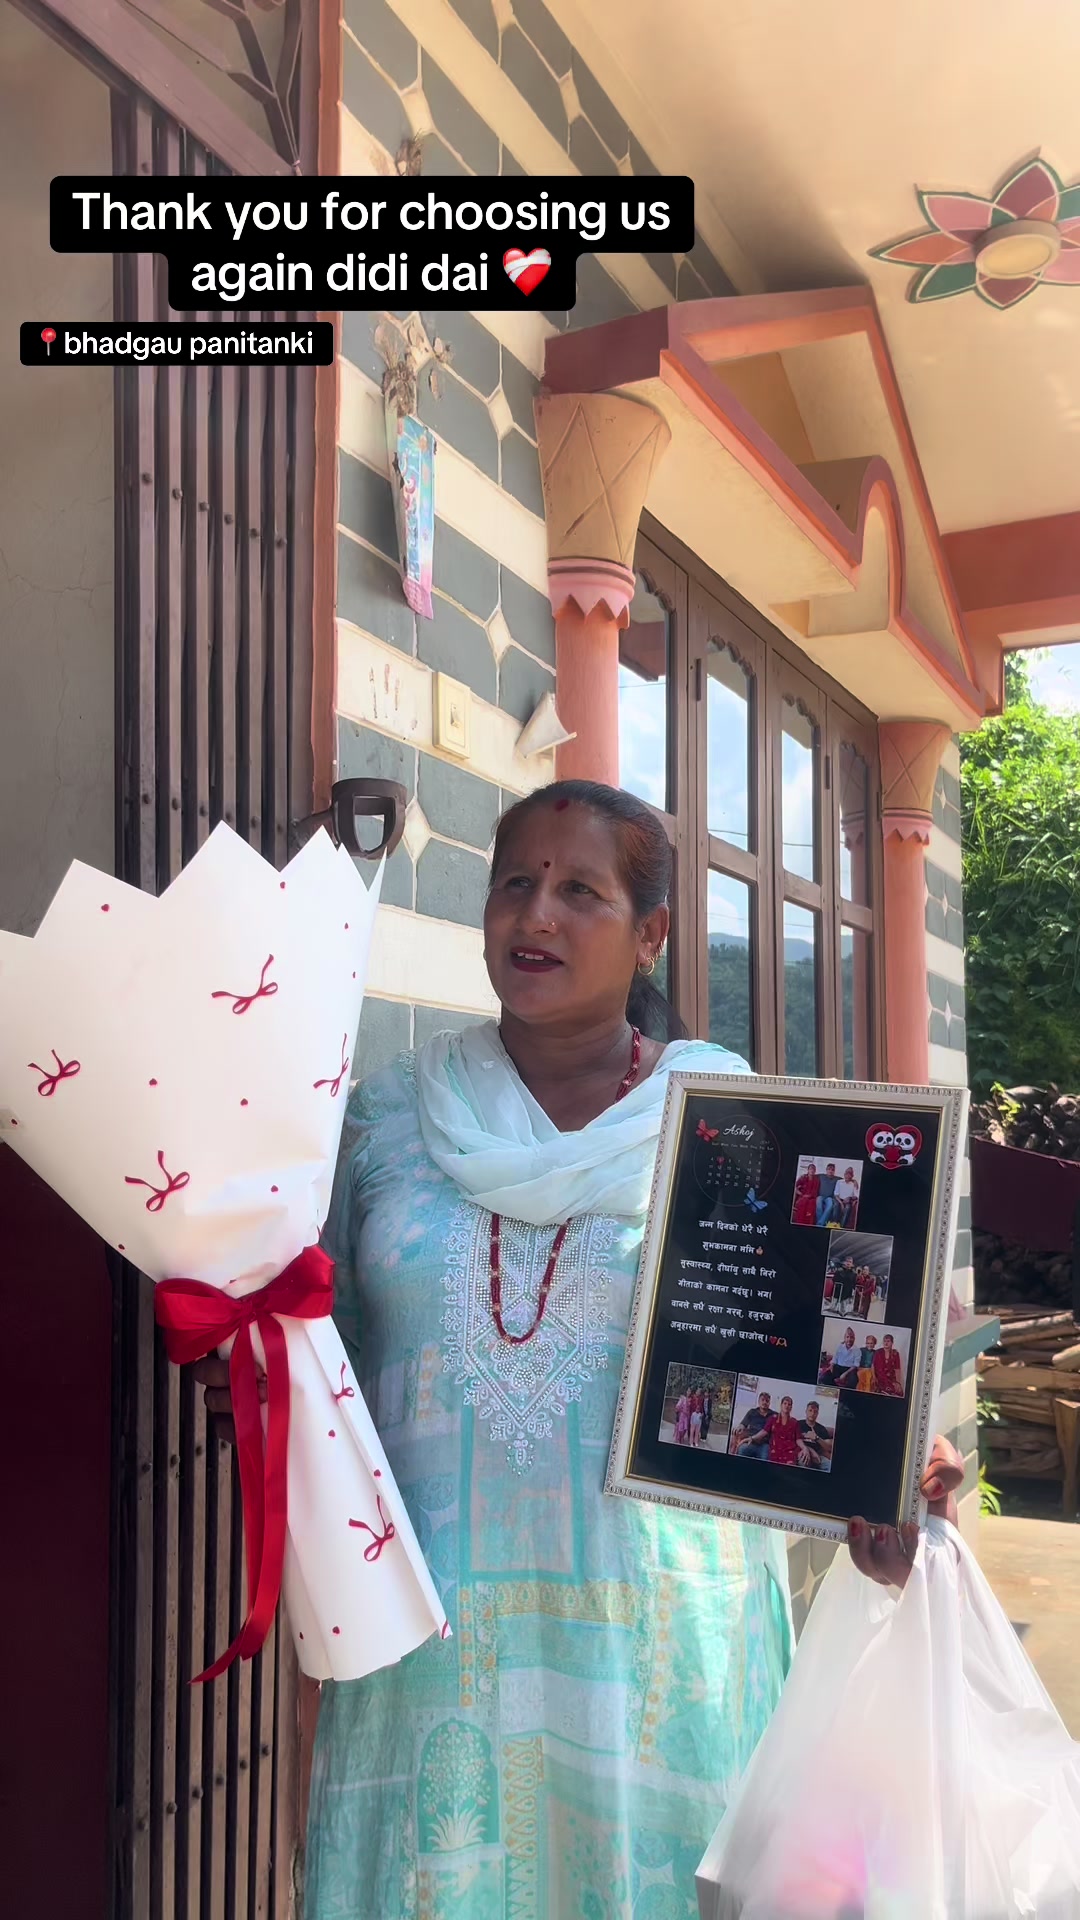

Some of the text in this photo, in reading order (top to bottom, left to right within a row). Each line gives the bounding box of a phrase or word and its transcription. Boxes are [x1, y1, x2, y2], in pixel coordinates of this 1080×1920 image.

[722, 1124, 755, 1141] Ashoj
[698, 1220, 714, 1229] जन्म
[716, 1220, 739, 1231] दिनको
[741, 1223, 753, 1234] धेरै
[702, 1241, 737, 1251] शुभकामना
[706, 1283, 729, 1293] कामना
